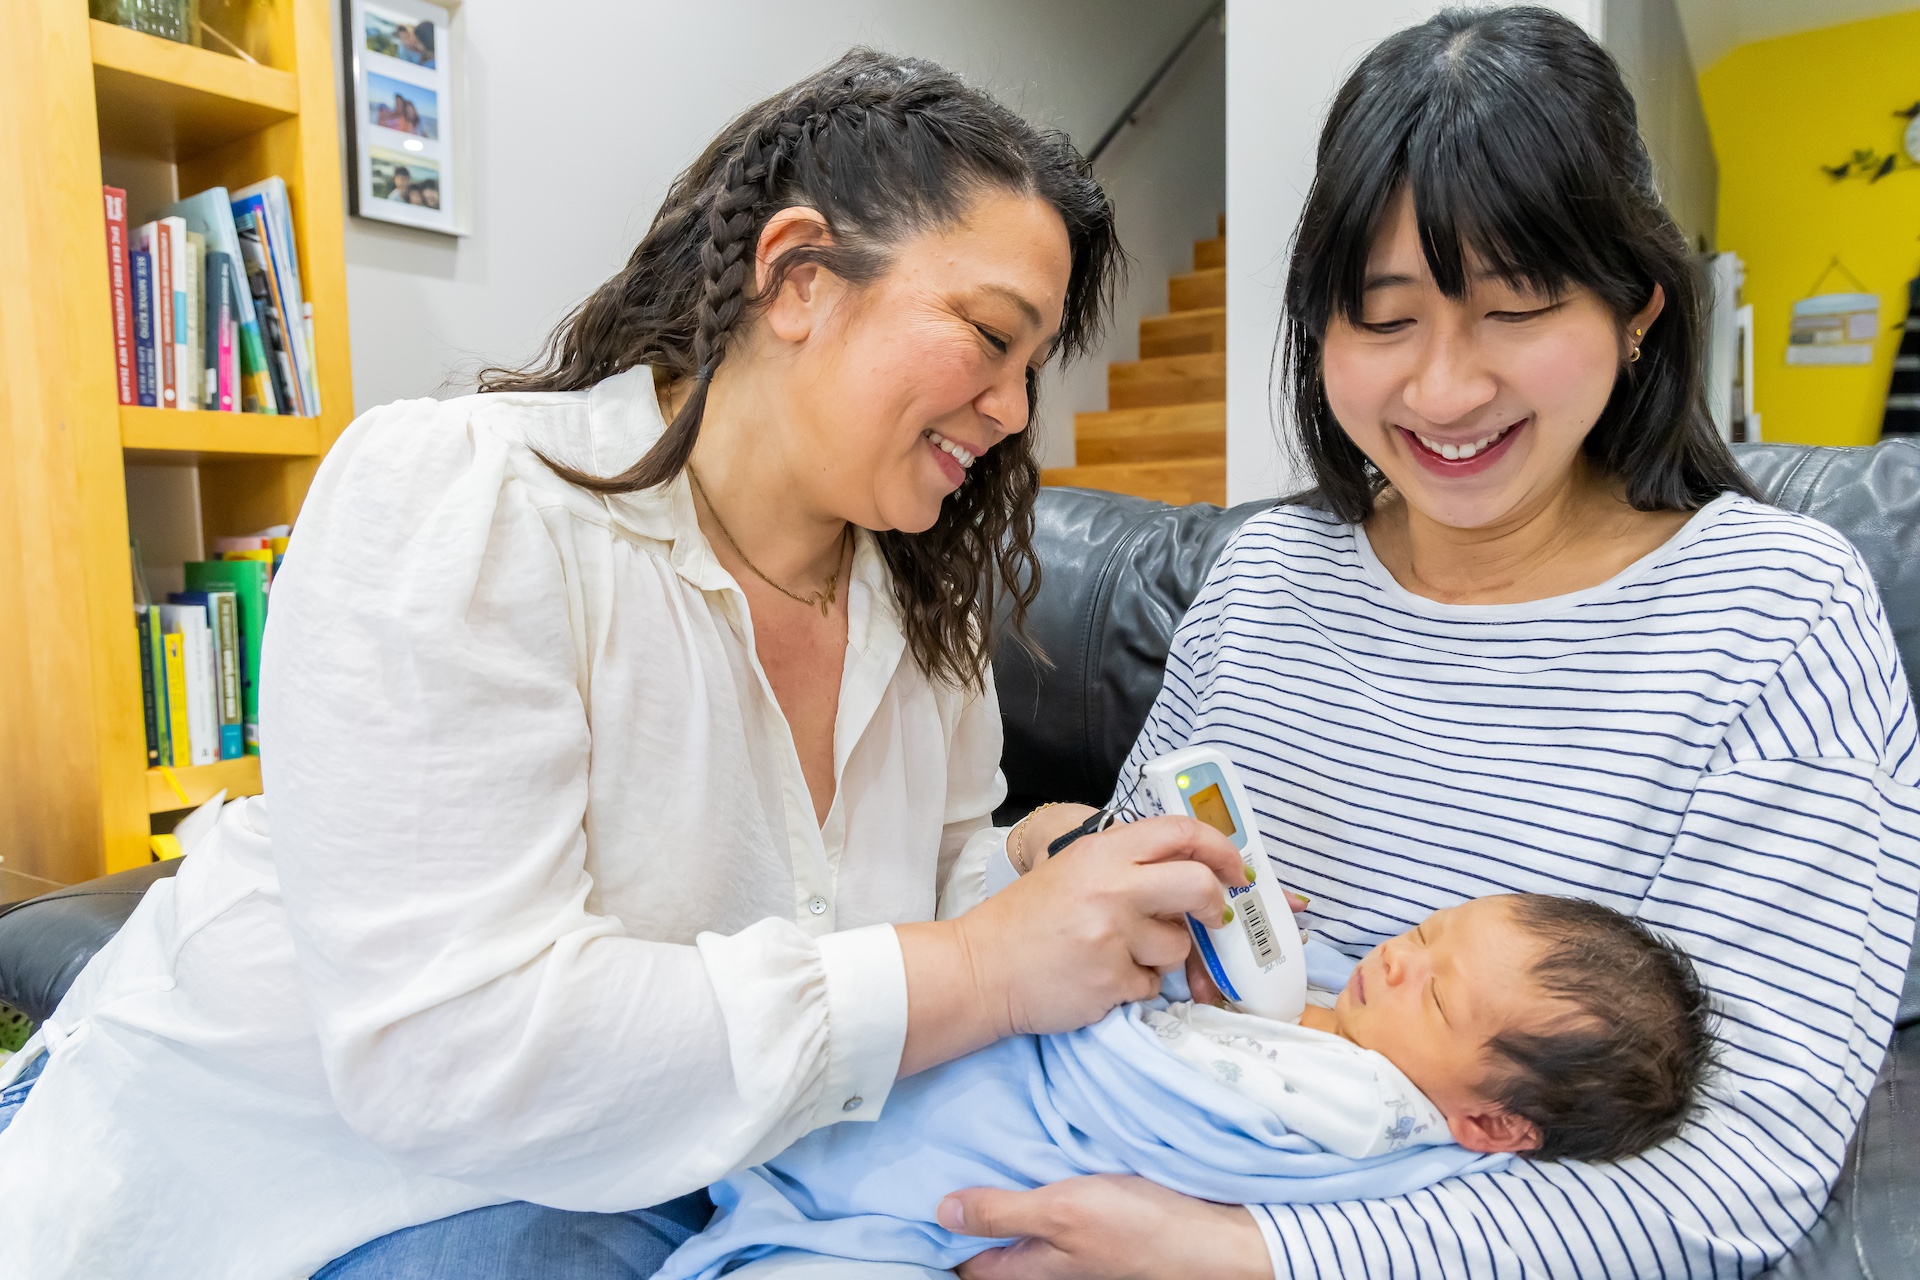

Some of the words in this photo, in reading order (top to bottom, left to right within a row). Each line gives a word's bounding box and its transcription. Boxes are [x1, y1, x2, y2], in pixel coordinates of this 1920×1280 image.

[110, 226, 120, 245] EPIC
[112, 245, 122, 264] BIKE
[114, 264, 124, 288] RIDES
[136, 256, 147, 278] SUE
[138, 278, 148, 310] MONK
[116, 296, 127, 339] AUSTRALIA
[119, 346, 128, 366] NEW
[120, 366, 131, 403] ZEALAND
[1264, 955, 1286, 974] JM-103
